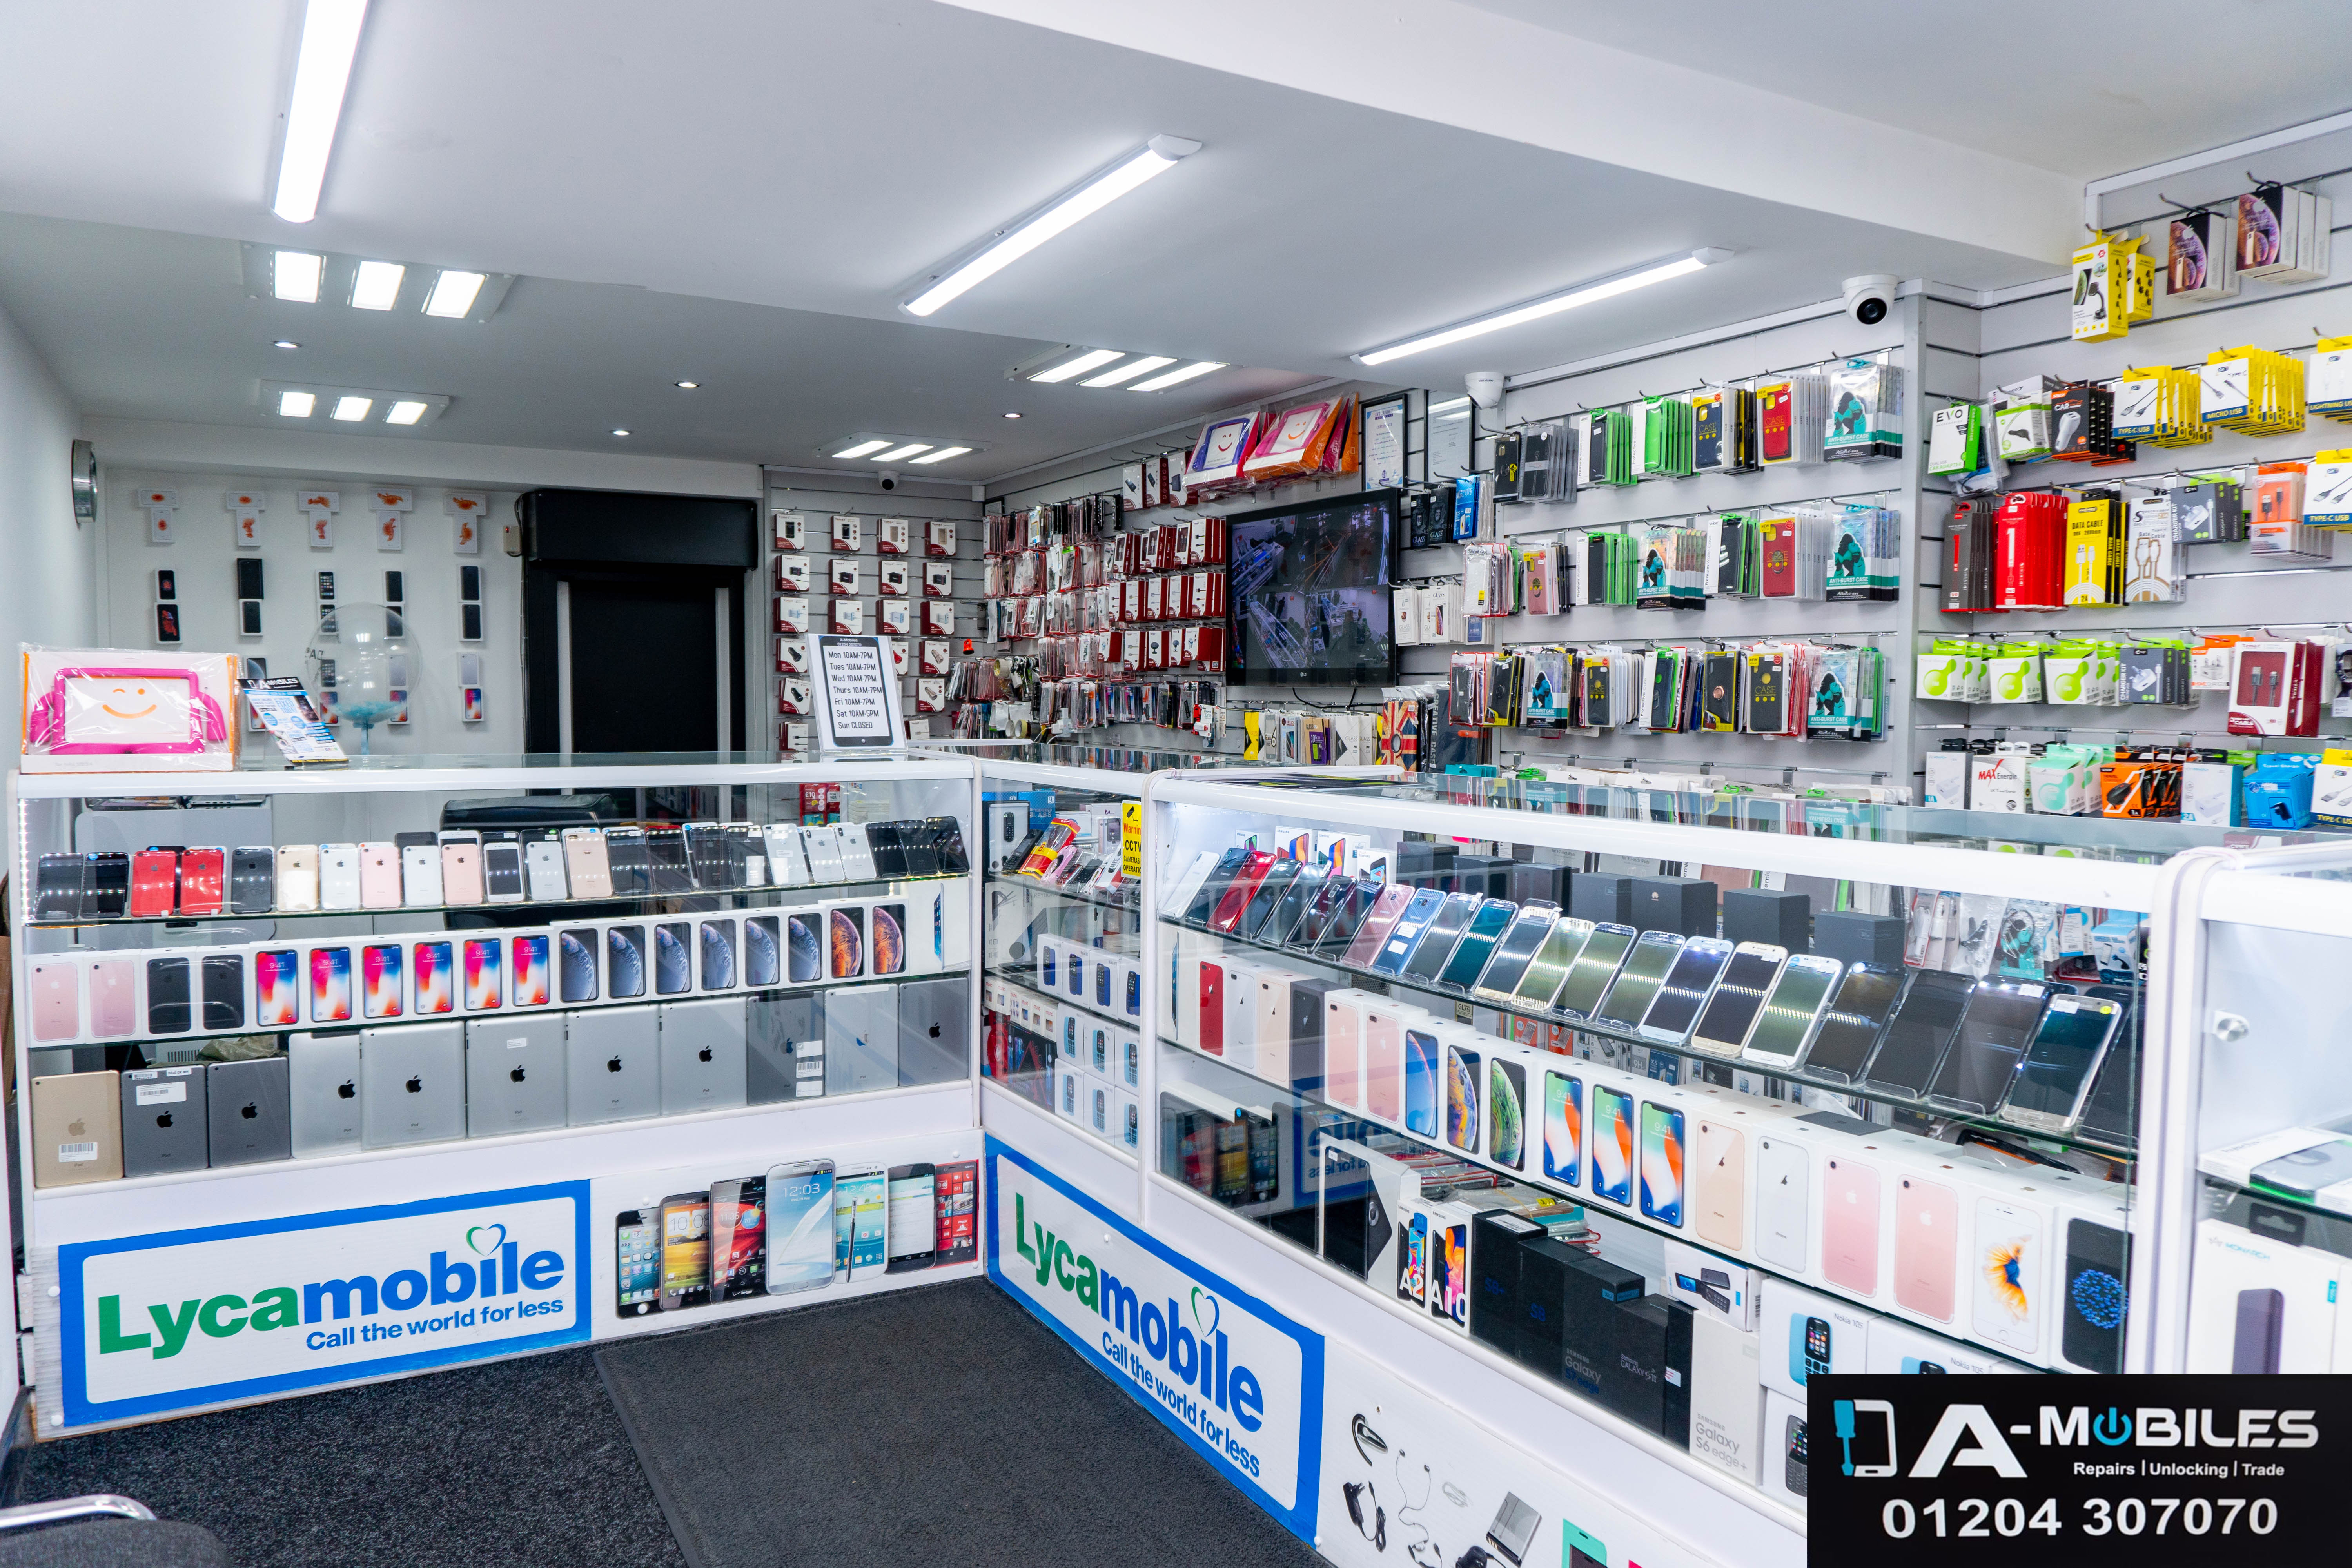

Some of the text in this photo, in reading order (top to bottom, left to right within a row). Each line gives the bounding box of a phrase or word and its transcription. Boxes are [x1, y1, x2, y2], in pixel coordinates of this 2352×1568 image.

[1765, 415, 1785, 426] CASE
[1937, 409, 1963, 422] EVO
[2207, 410, 2229, 419] MICRO
[1699, 422, 1716, 433] CASE
[2118, 426, 2138, 434] TYPE-C
[2087, 519, 2103, 528] CABLE
[2309, 514, 2334, 523] TYPE-C
[1755, 686, 1776, 694] CASE
[1430, 693, 1439, 737] CREATIVE
[1997, 772, 2018, 780] Energie
[2317, 815, 2342, 824] TYPE-C
[1123, 855, 1140, 864] CAMERAS
[1458, 1004, 1471, 1013] GLASS
[1633, 1060, 1642, 1069] 9H
[1556, 1090, 1570, 1101] 9:41
[1605, 1105, 1621, 1116] 9:41
[1654, 1121, 1671, 1133] 9:41
[783, 1183, 820, 1198] 12:03
[844, 1183, 873, 1195] 12:45
[1398, 1205, 1410, 1214] SAMSUNG
[1433, 1211, 1446, 1220] SAMSUNG
[1399, 1267, 1424, 1301] A2
[1485, 1277, 1504, 1295] S8+
[98, 1224, 565, 1360] Lycamobile
[1431, 1279, 1466, 1322] A10
[1016, 1192, 1263, 1432] Lycamobile
[1530, 1303, 1546, 1322] S8
[306, 1296, 563, 1351] Call the world for less
[1833, 1312, 1864, 1329] Nokia 105
[1567, 1348, 1590, 1363] SAMSUNG
[1565, 1356, 1601, 1384] Galaxy
[1950, 1357, 1984, 1374] Nokia 105
[1577, 1376, 1599, 1394] edge
[1102, 1331, 1259, 1478] Call the world for less
[1697, 1413, 1726, 1432] SAMSUNG
[1696, 1421, 1740, 1455] Galaxy
[1696, 1436, 1710, 1453] S6
